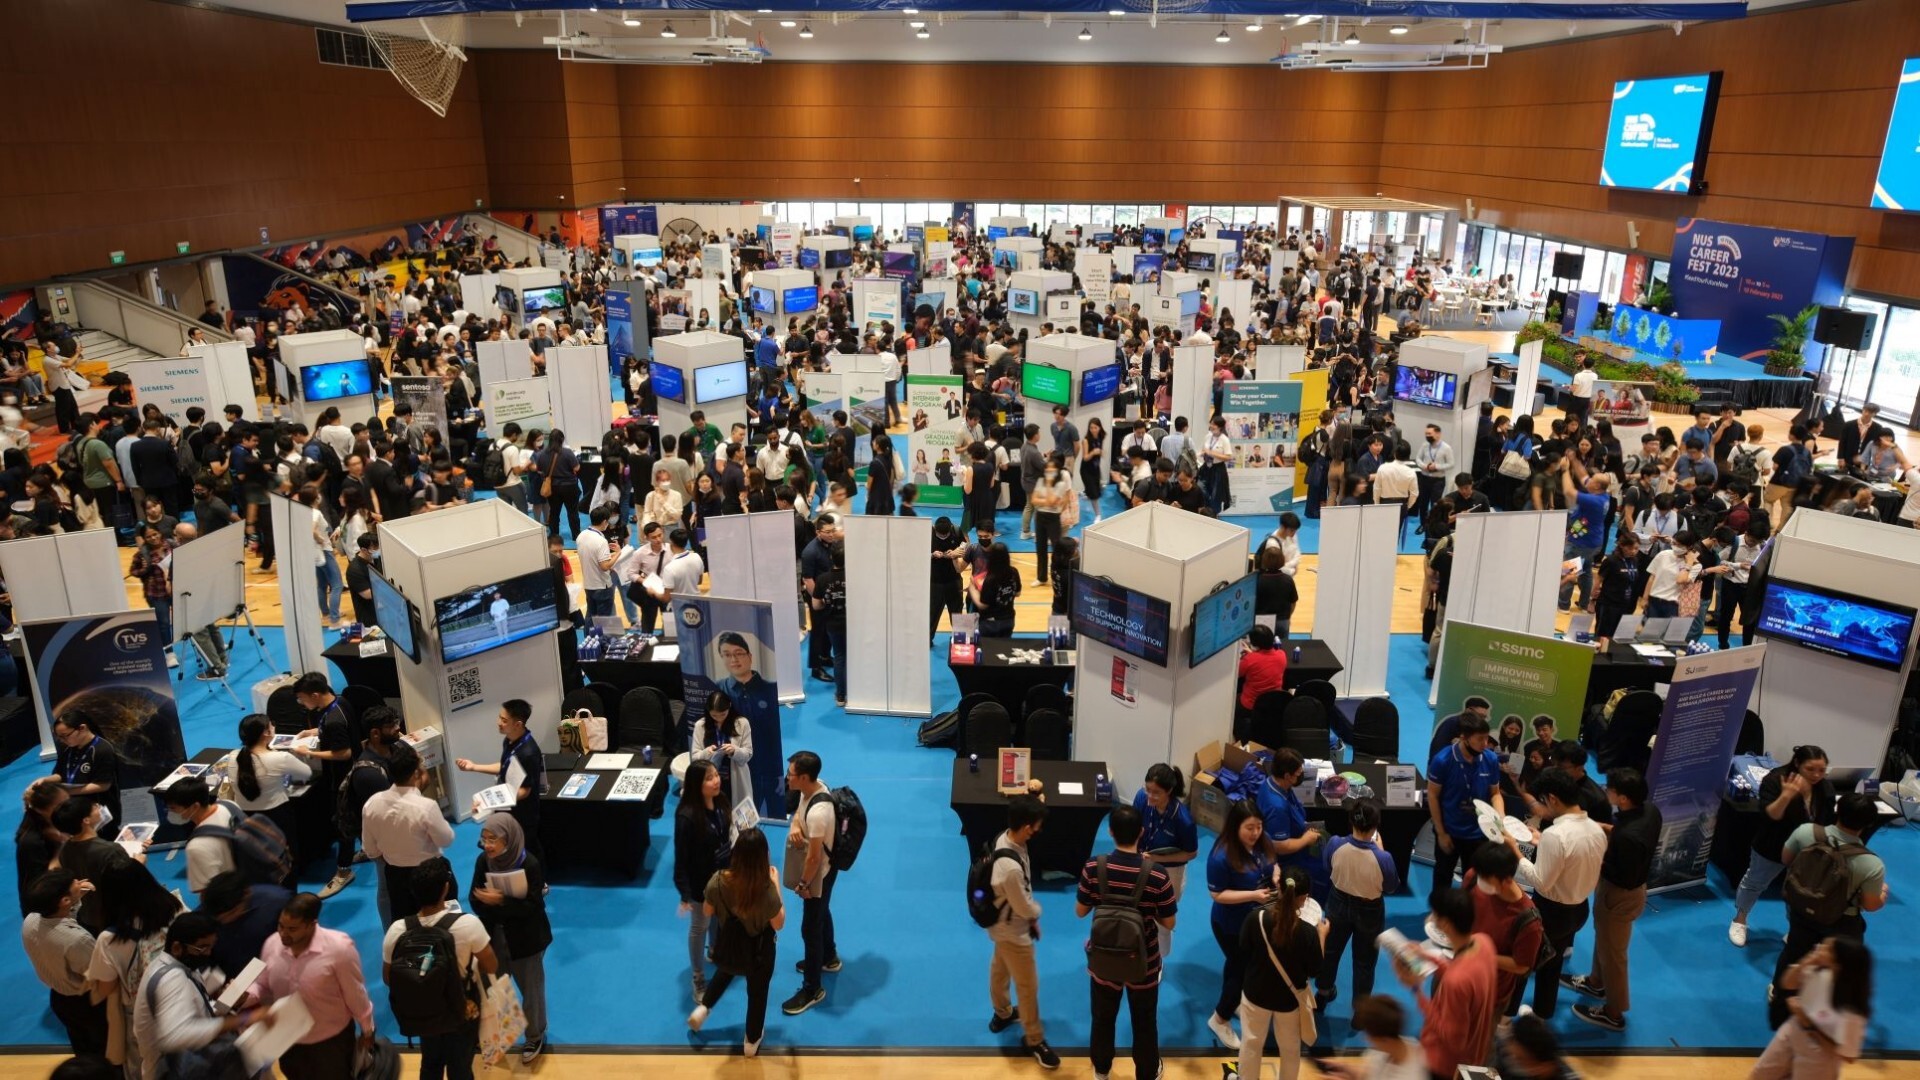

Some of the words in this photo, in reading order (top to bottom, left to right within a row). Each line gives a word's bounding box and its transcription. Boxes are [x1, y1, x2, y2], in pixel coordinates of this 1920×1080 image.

[1692, 233, 1714, 247] NUS
[1690, 246, 1730, 264] CAREER
[1687, 258, 1712, 274] FEST
[1712, 263, 1740, 279] 2023
[164, 368, 199, 376] SIEMENS
[401, 383, 431, 391] sentosa
[1091, 607, 1144, 632] TECHNOLOGY
[1767, 616, 1785, 625] MORE
[1815, 627, 1840, 638] OFFICES
[121, 633, 148, 644] TVS
[1095, 617, 1124, 633] SUPPORT
[1125, 627, 1162, 646] INNOVATION
[1501, 642, 1545, 659] ssmc
[1484, 663, 1540, 681] IMPROVING
[1685, 667, 1696, 675] SJ
[1491, 674, 1509, 683] LIVES
[1523, 681, 1544, 690] TOUCH
[1706, 690, 1723, 698] CAREER
[1676, 700, 1698, 708] SURBANA
[1697, 697, 1717, 705] JURONG
